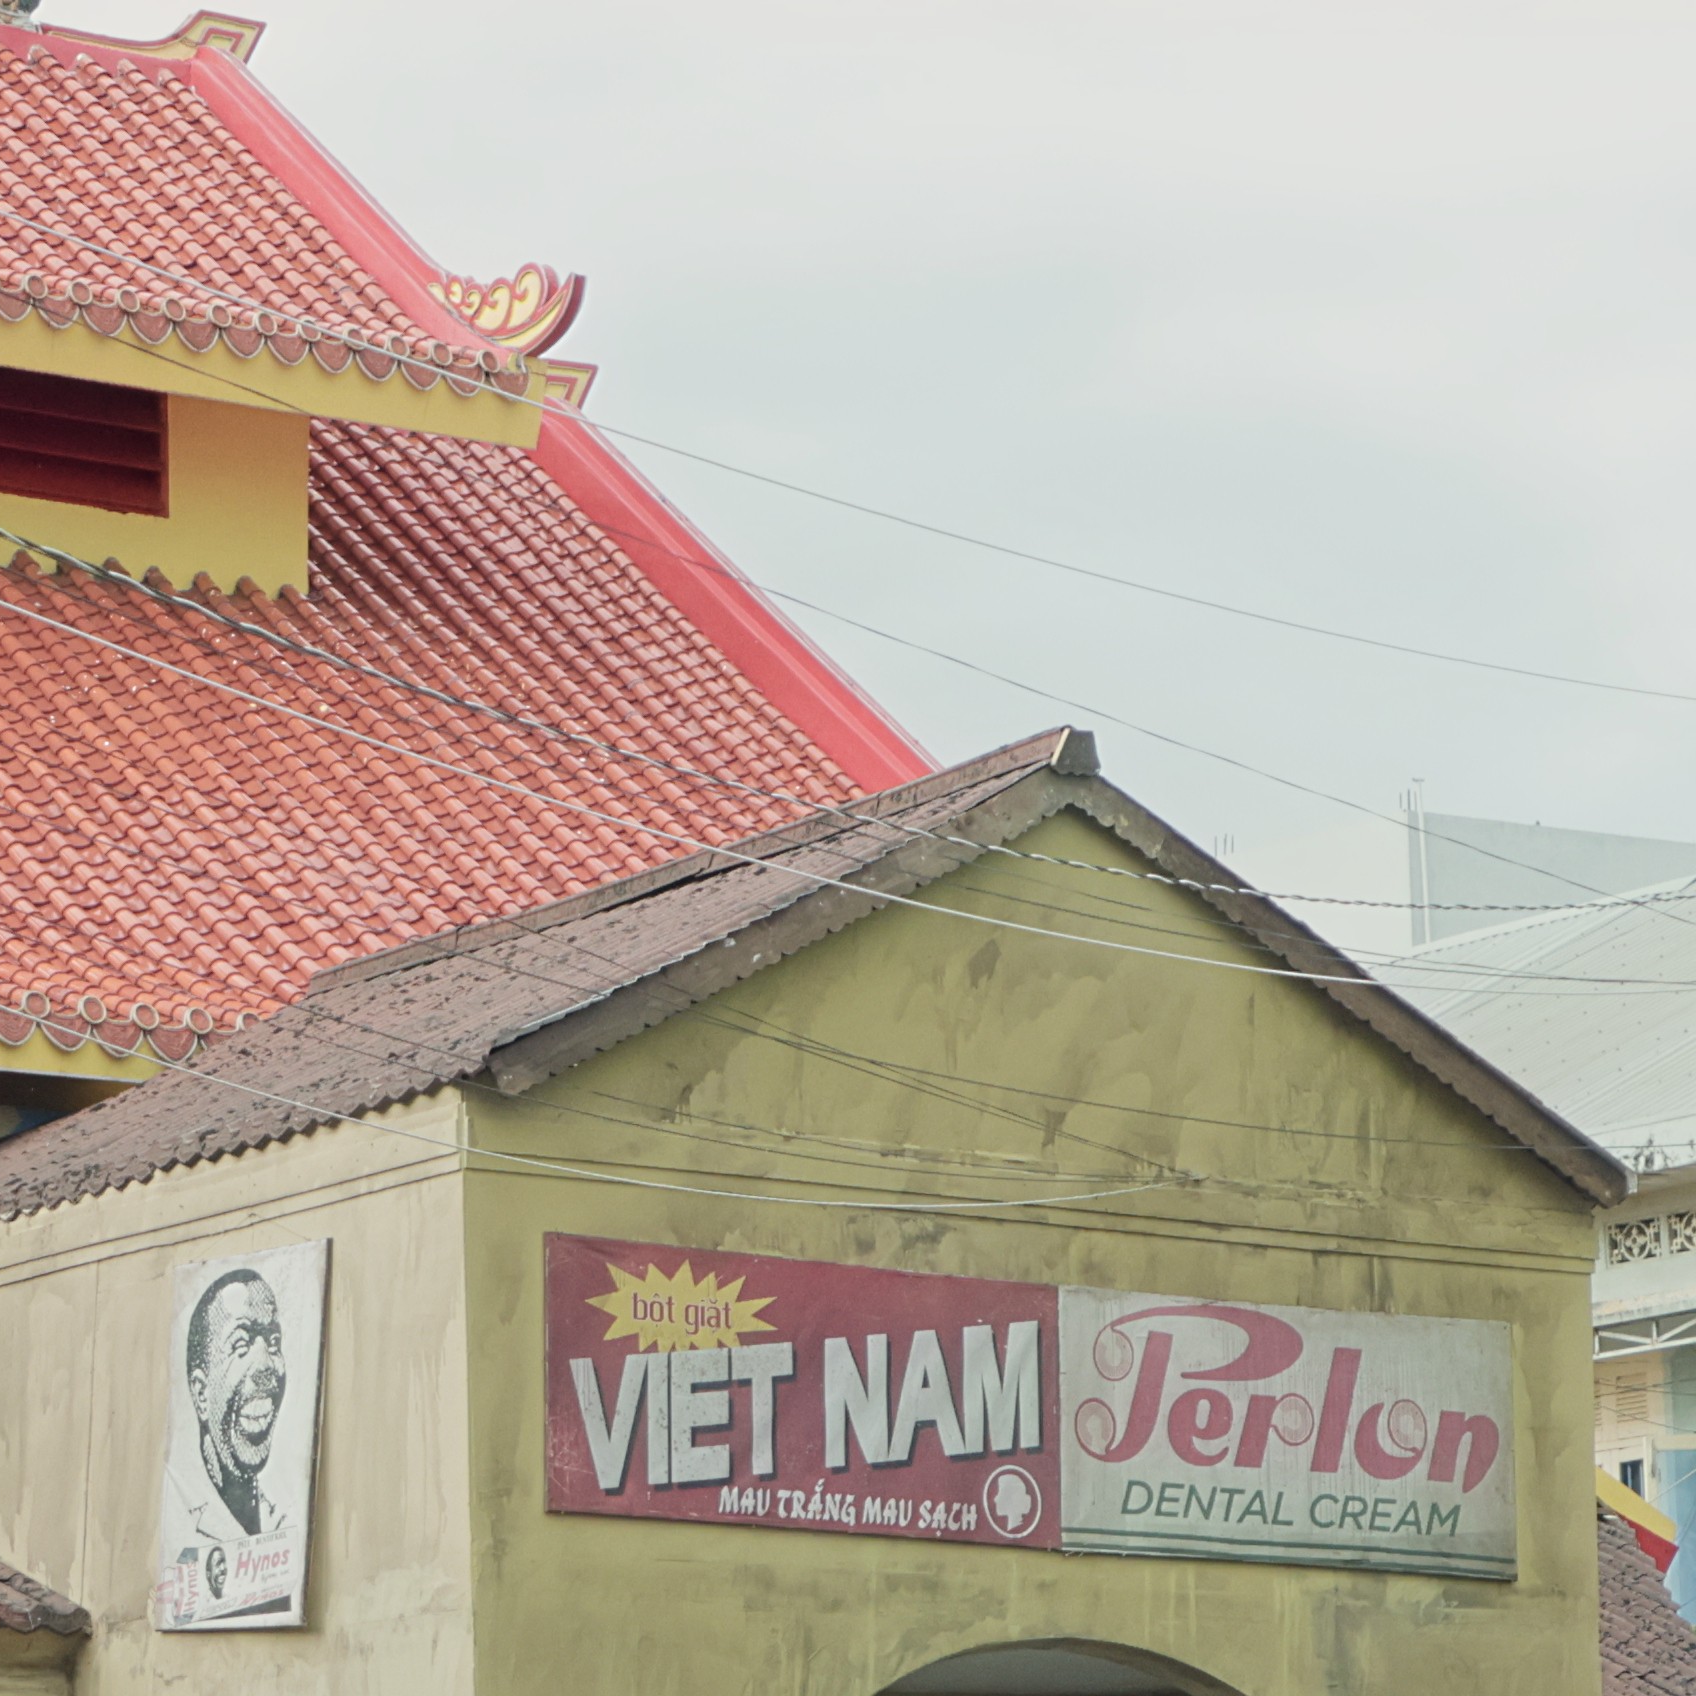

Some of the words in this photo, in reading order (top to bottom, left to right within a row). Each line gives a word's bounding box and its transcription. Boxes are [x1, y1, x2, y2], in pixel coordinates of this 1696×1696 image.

[632, 1292, 675, 1328] bột
[684, 1298, 732, 1335] giặt
[569, 1342, 794, 1490] VIET
[824, 1320, 1042, 1469] NAM
[1075, 1305, 1500, 1494] Perlon
[718, 1485, 771, 1517] MAU
[776, 1478, 856, 1526] TRẮNG
[862, 1496, 913, 1527] MAU
[918, 1499, 978, 1537] SẠCH
[1120, 1480, 1294, 1527] DENTAL
[1310, 1493, 1462, 1538] CREAM
[234, 1548, 291, 1583] Hynos
